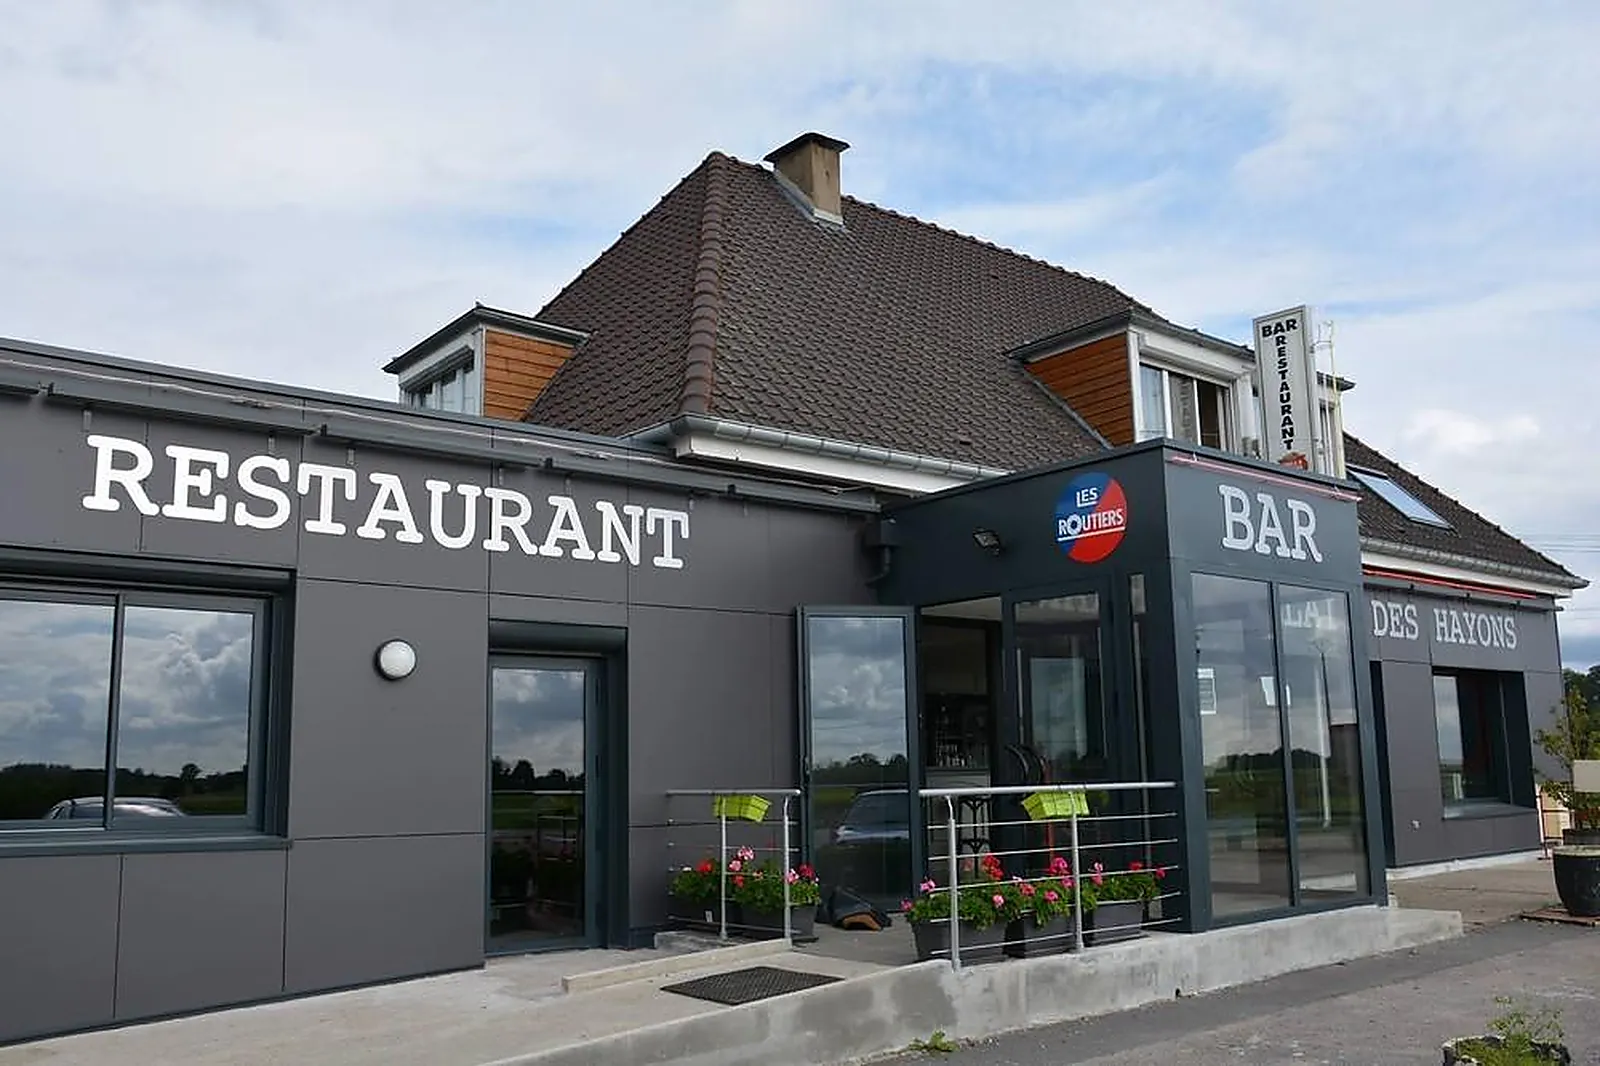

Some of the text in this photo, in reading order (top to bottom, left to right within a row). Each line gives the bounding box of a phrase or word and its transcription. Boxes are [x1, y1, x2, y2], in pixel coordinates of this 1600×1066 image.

[1262, 319, 1298, 337] BAR
[1275, 335, 1295, 450] RESTAURANT
[82, 434, 690, 569] RESTAURANT
[1076, 487, 1099, 507] LES
[1057, 509, 1125, 537] ROUTIERS
[1218, 485, 1323, 563] BAR
[1371, 600, 1419, 639] DES
[1433, 608, 1517, 649] HAYONS
